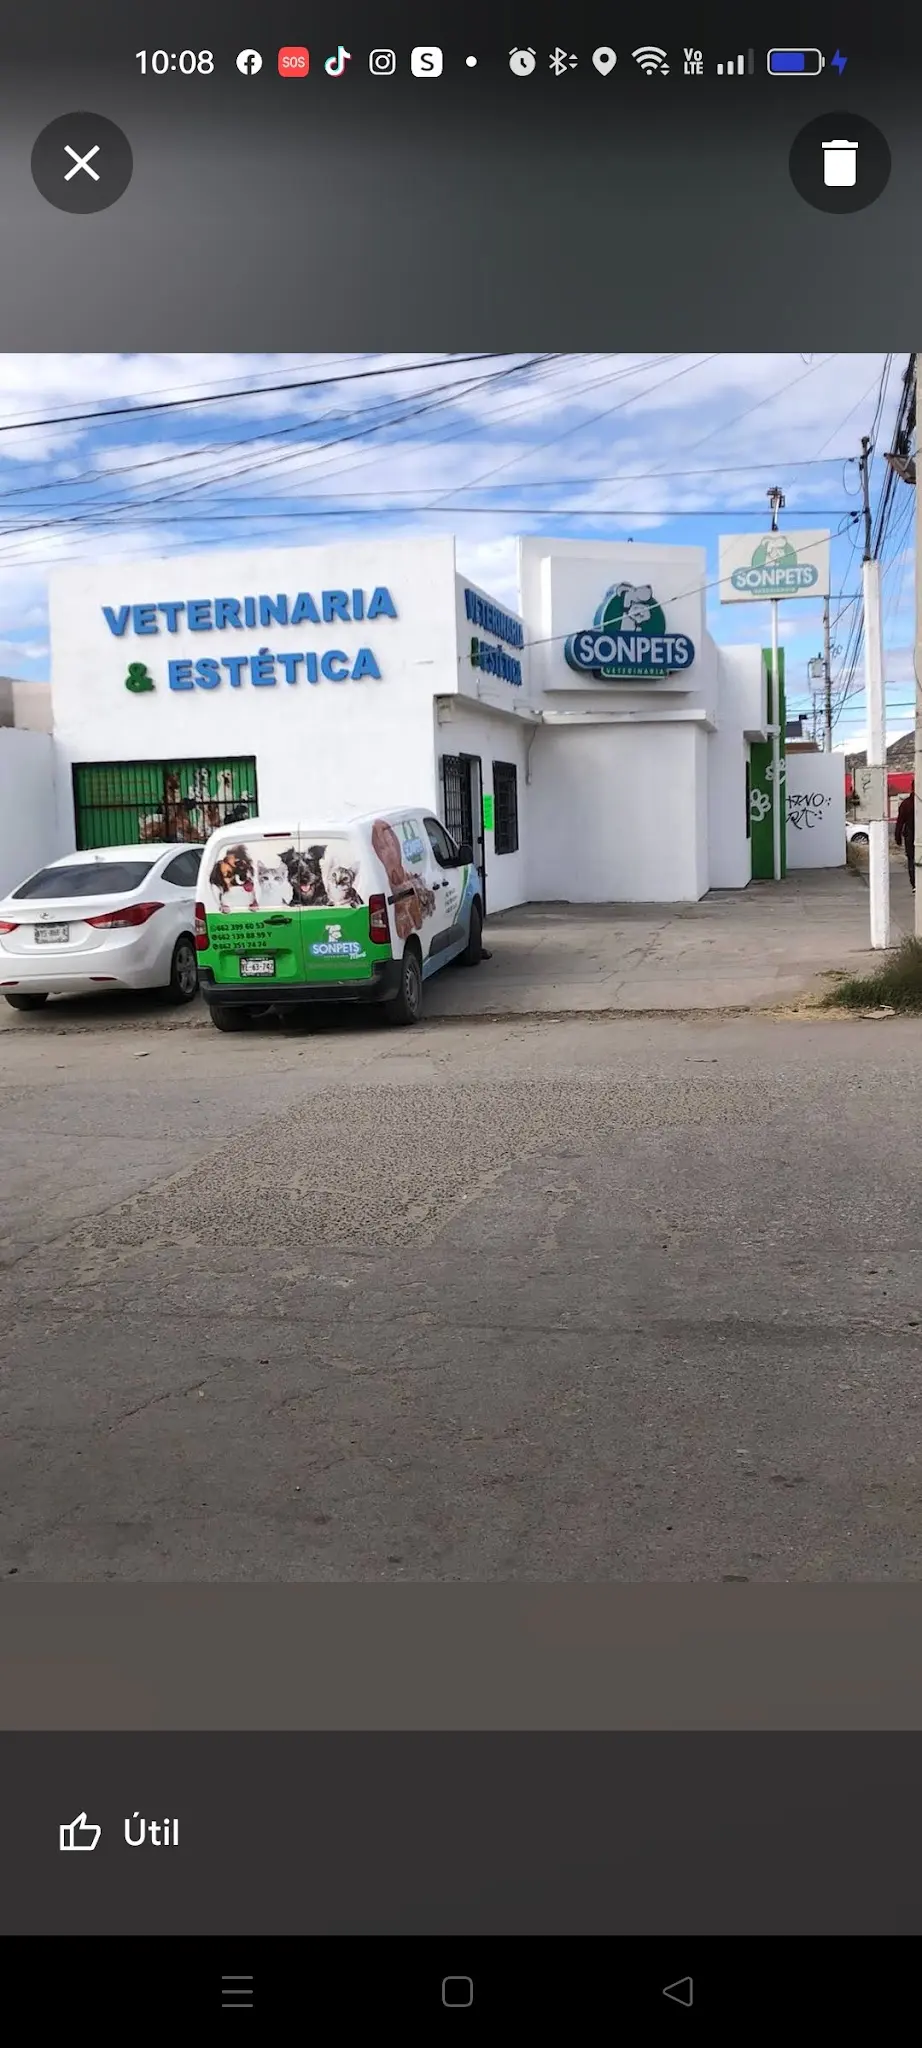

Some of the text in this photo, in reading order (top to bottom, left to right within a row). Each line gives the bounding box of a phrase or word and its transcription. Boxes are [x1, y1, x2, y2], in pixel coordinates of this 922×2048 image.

[736, 566, 813, 588] SONPETS
[101, 586, 398, 637] VETERINARIA
[579, 635, 689, 664] SONPETS
[125, 647, 382, 693] & ESTÉTICA
[312, 941, 360, 955] SONPETS
